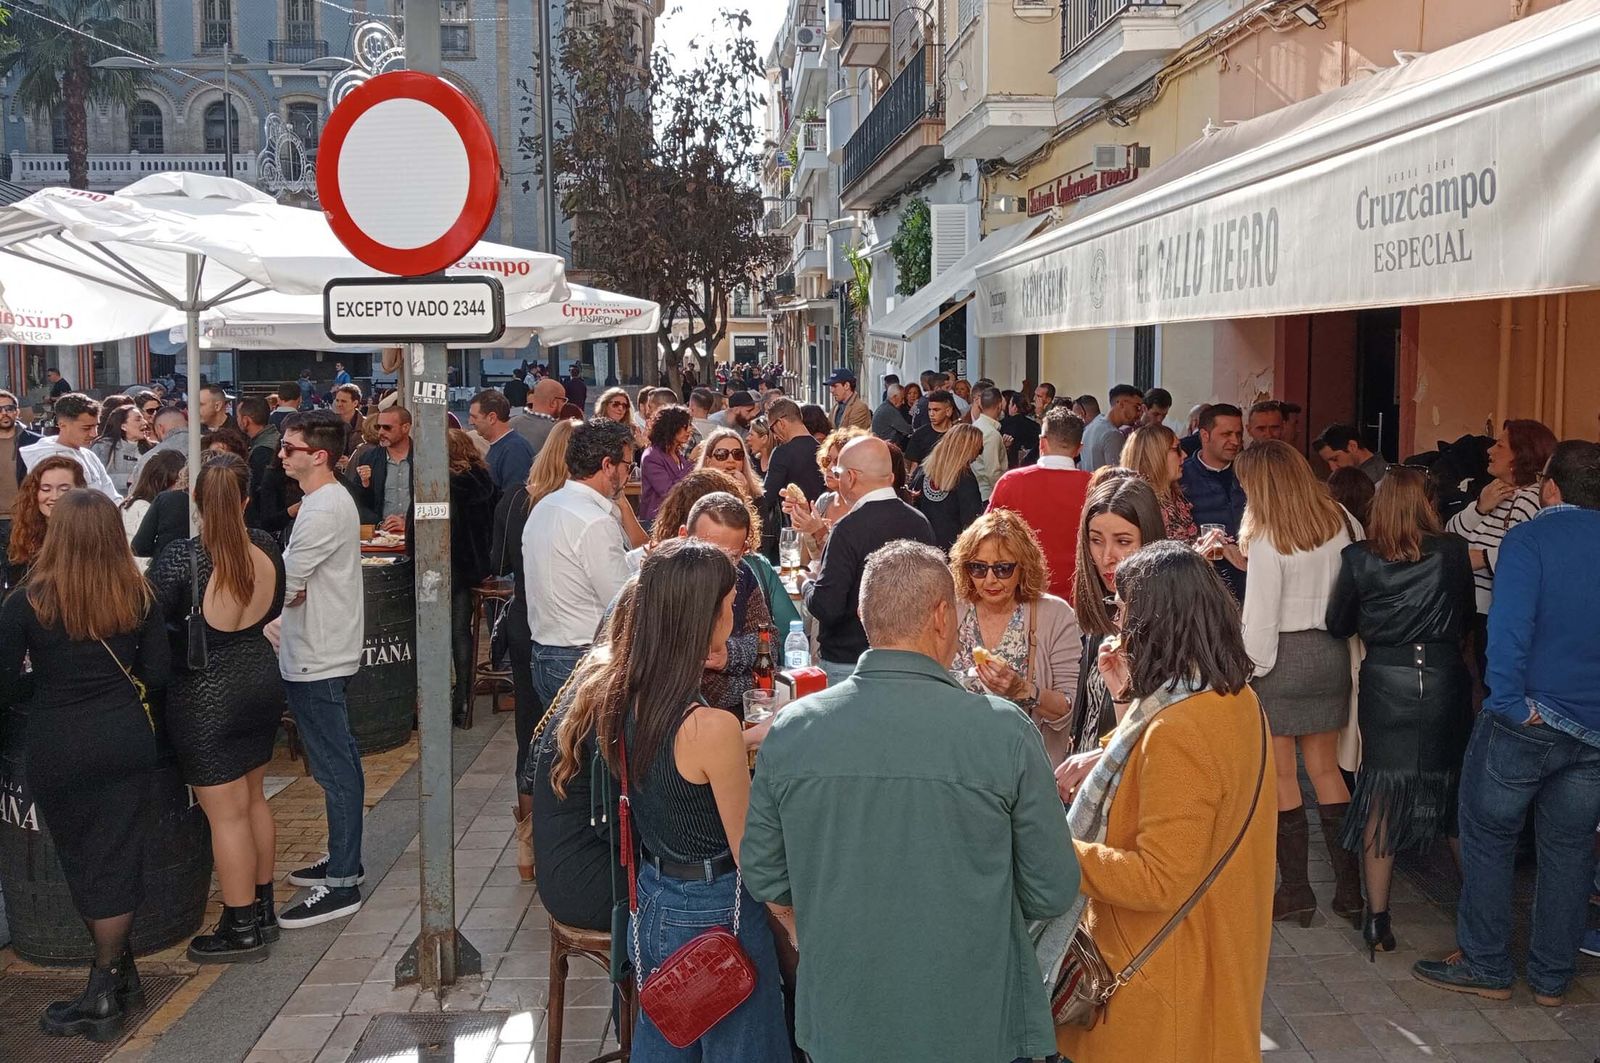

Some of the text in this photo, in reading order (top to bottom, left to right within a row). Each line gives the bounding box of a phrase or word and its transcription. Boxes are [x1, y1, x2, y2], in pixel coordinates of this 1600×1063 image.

[1356, 167, 1497, 231] Cruzcampo
[1136, 207, 1279, 304] EL GALLO NEGRO
[1374, 229, 1472, 273] ESPECIAL
[336, 300, 486, 317] EXCEPTO VADO 2344
[413, 381, 447, 399] LIER
[362, 642, 412, 667] TANA
